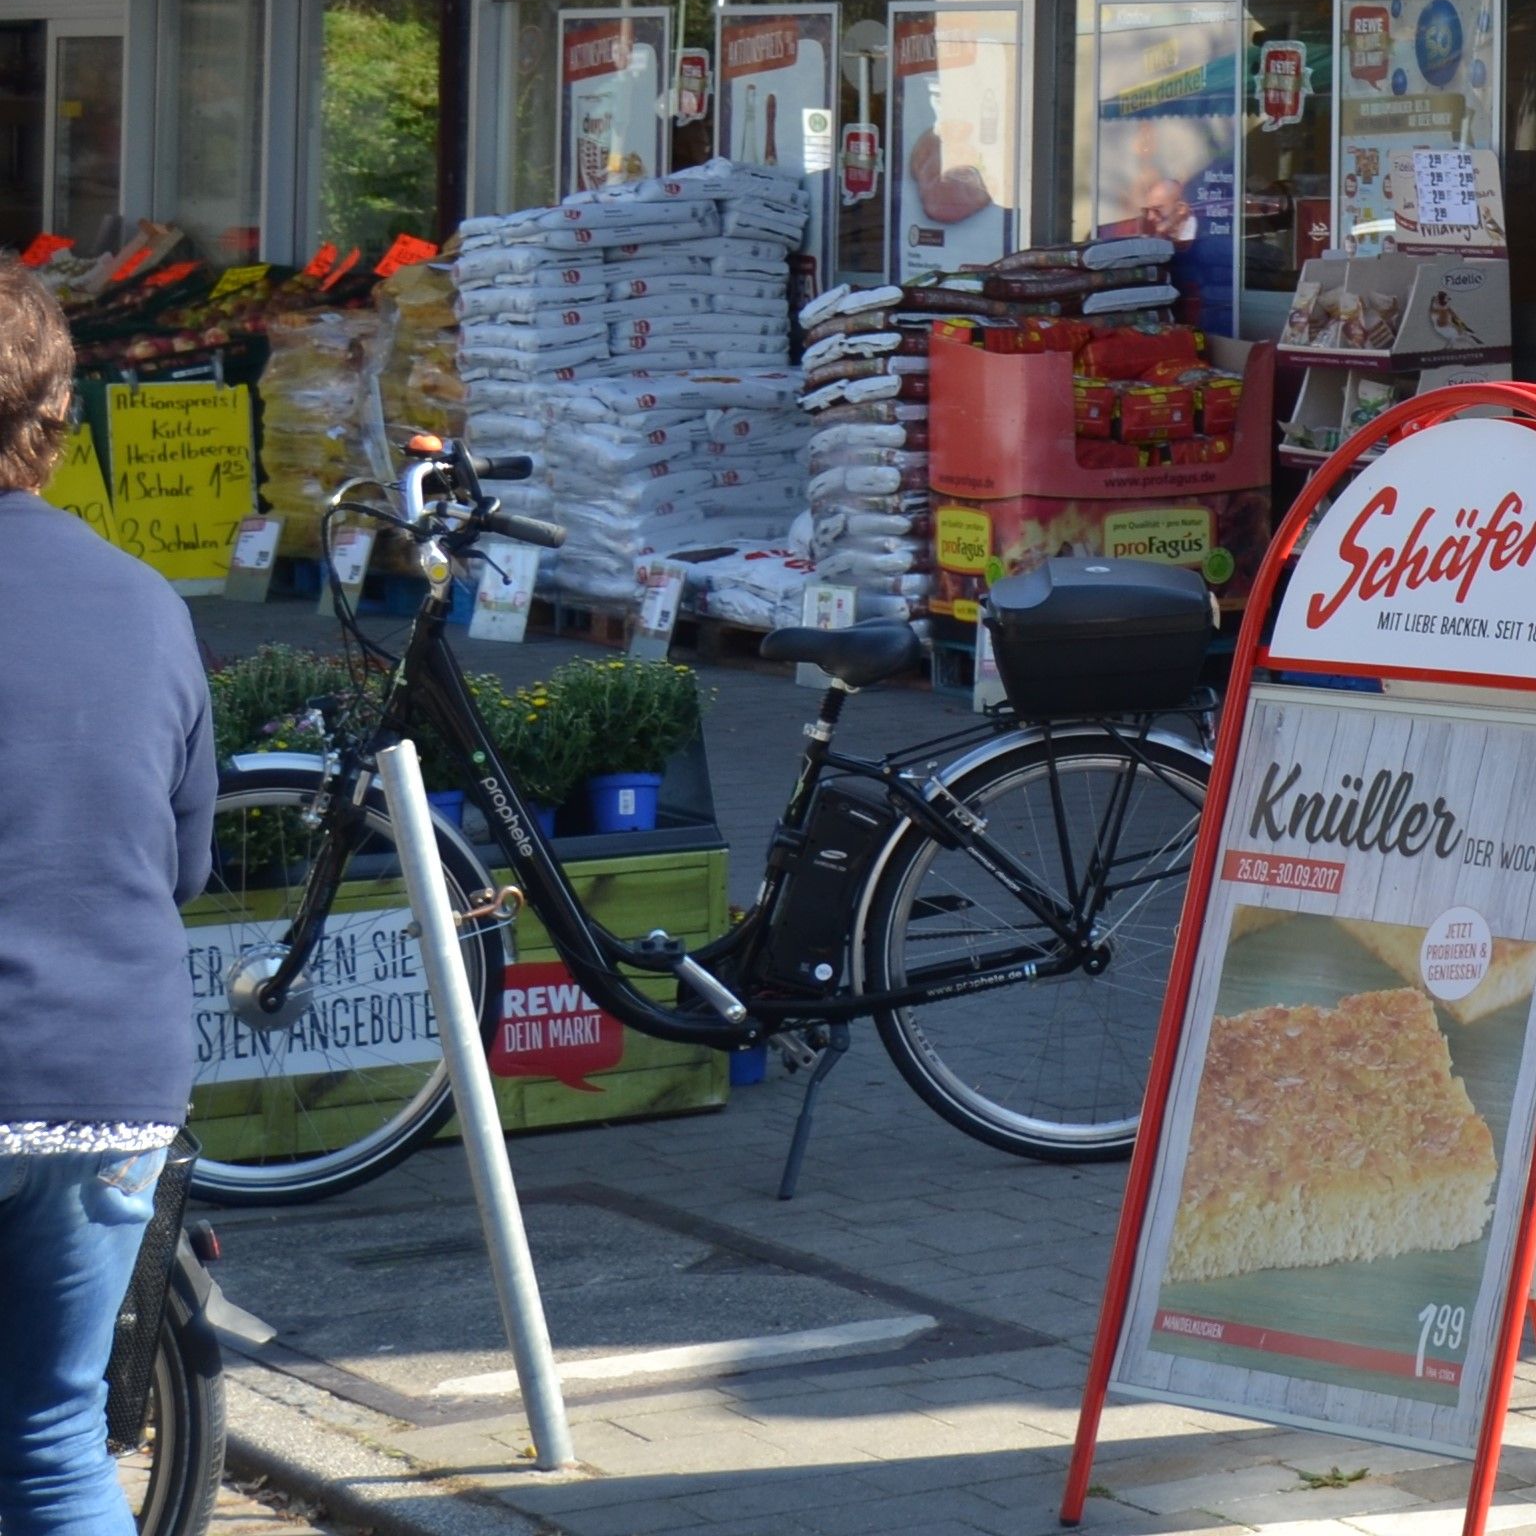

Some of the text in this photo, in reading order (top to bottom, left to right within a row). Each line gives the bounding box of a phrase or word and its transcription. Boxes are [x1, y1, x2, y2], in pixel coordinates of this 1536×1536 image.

[1354, 17, 1384, 34] REWE
[1444, 274, 1483, 286] Fidelio
[151, 419, 220, 440] Kultur
[126, 444, 249, 466] Heidelbeeren
[136, 471, 195, 500] Schale
[1103, 468, 1217, 488] www.profagus.de
[149, 518, 219, 553] Schalen
[1376, 611, 1404, 632] MIT
[1404, 612, 1437, 635] LIEBE
[1440, 615, 1490, 639] BACKEN.
[1494, 620, 1524, 641] SEIT
[479, 776, 534, 857] prophete
[1249, 761, 1464, 859] Knüller
[1464, 837, 1494, 868] DER
[1445, 922, 1474, 939] JETZT
[1425, 941, 1488, 960] PROBIEREN &
[1427, 964, 1483, 982] GENIESSEN!
[504, 1014, 603, 1054] DEIN MARKT
[1161, 1314, 1225, 1340] MANDELKUCHEN
